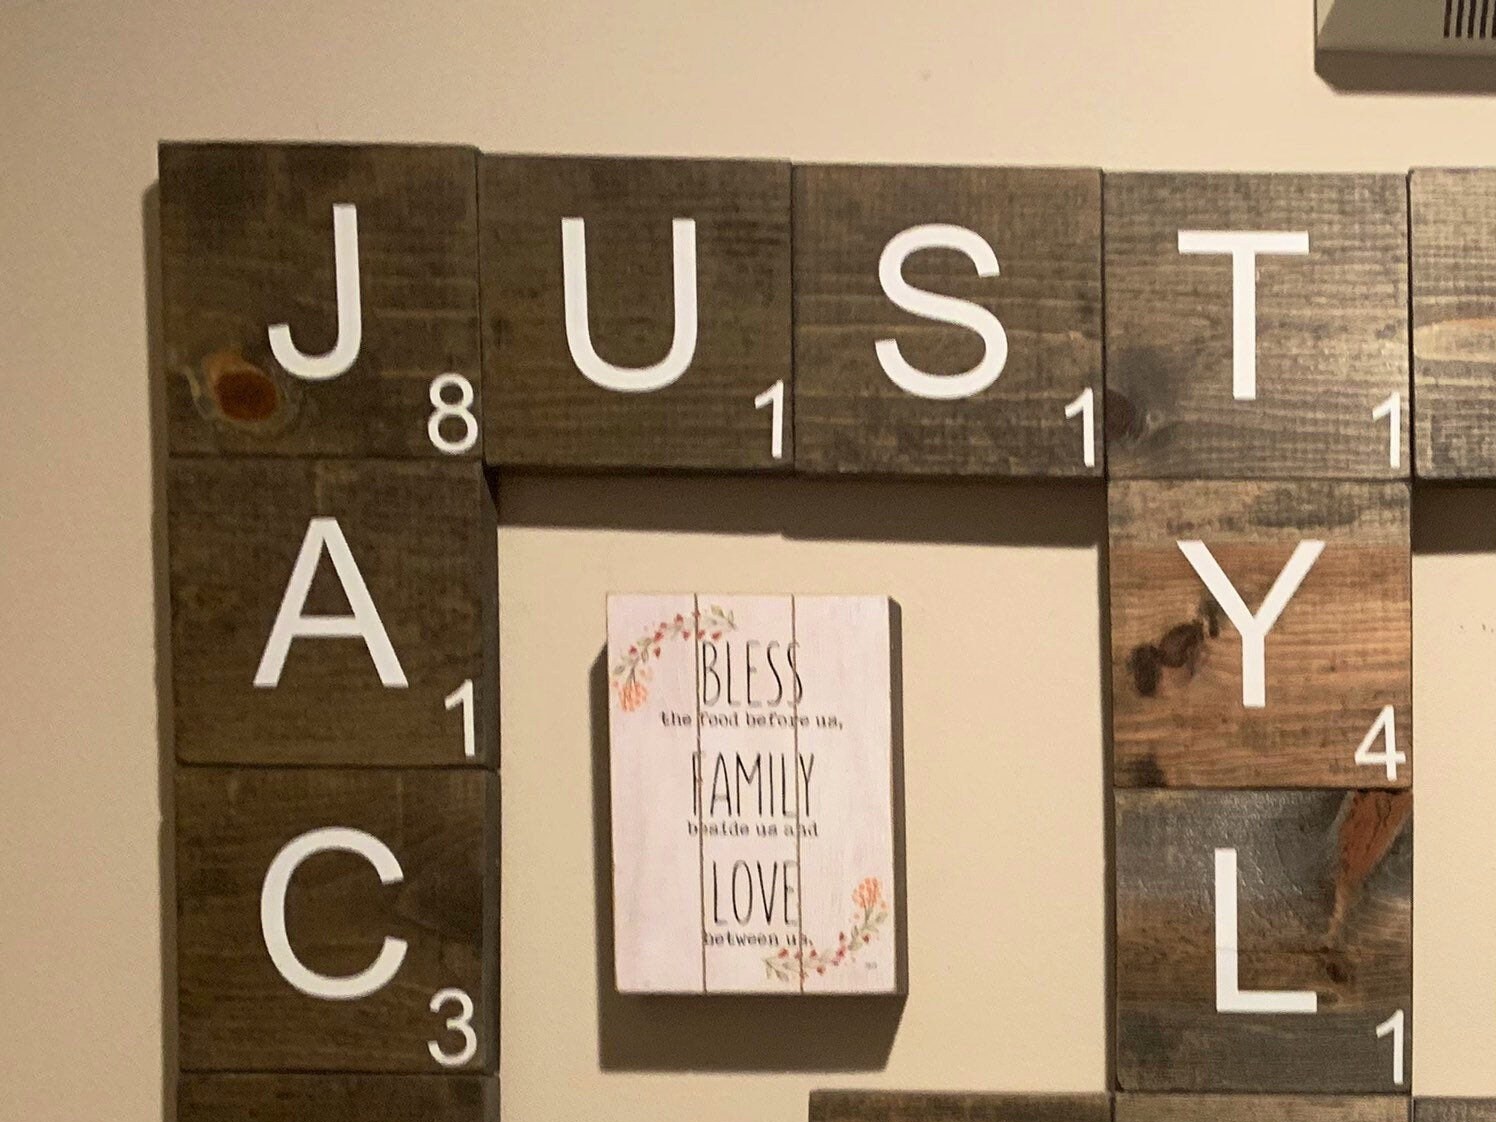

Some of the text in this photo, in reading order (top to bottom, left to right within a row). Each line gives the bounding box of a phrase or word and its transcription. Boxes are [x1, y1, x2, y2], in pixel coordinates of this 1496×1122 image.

[426, 372, 480, 456] 8
[752, 378, 785, 460] 1
[1063, 386, 1096, 468] 1
[1370, 394, 1404, 472] 1
[701, 640, 803, 707] BLESS
[443, 678, 476, 758] 1
[661, 711, 692, 726] the
[701, 711, 739, 728] food
[746, 712, 810, 728] before
[1353, 704, 1408, 782] 4
[692, 752, 815, 818] FAMILY
[756, 823, 777, 837] us
[712, 859, 798, 926] LOVE
[703, 931, 779, 946] between
[427, 987, 478, 1067] 3
[1374, 1008, 1405, 1086] 1
